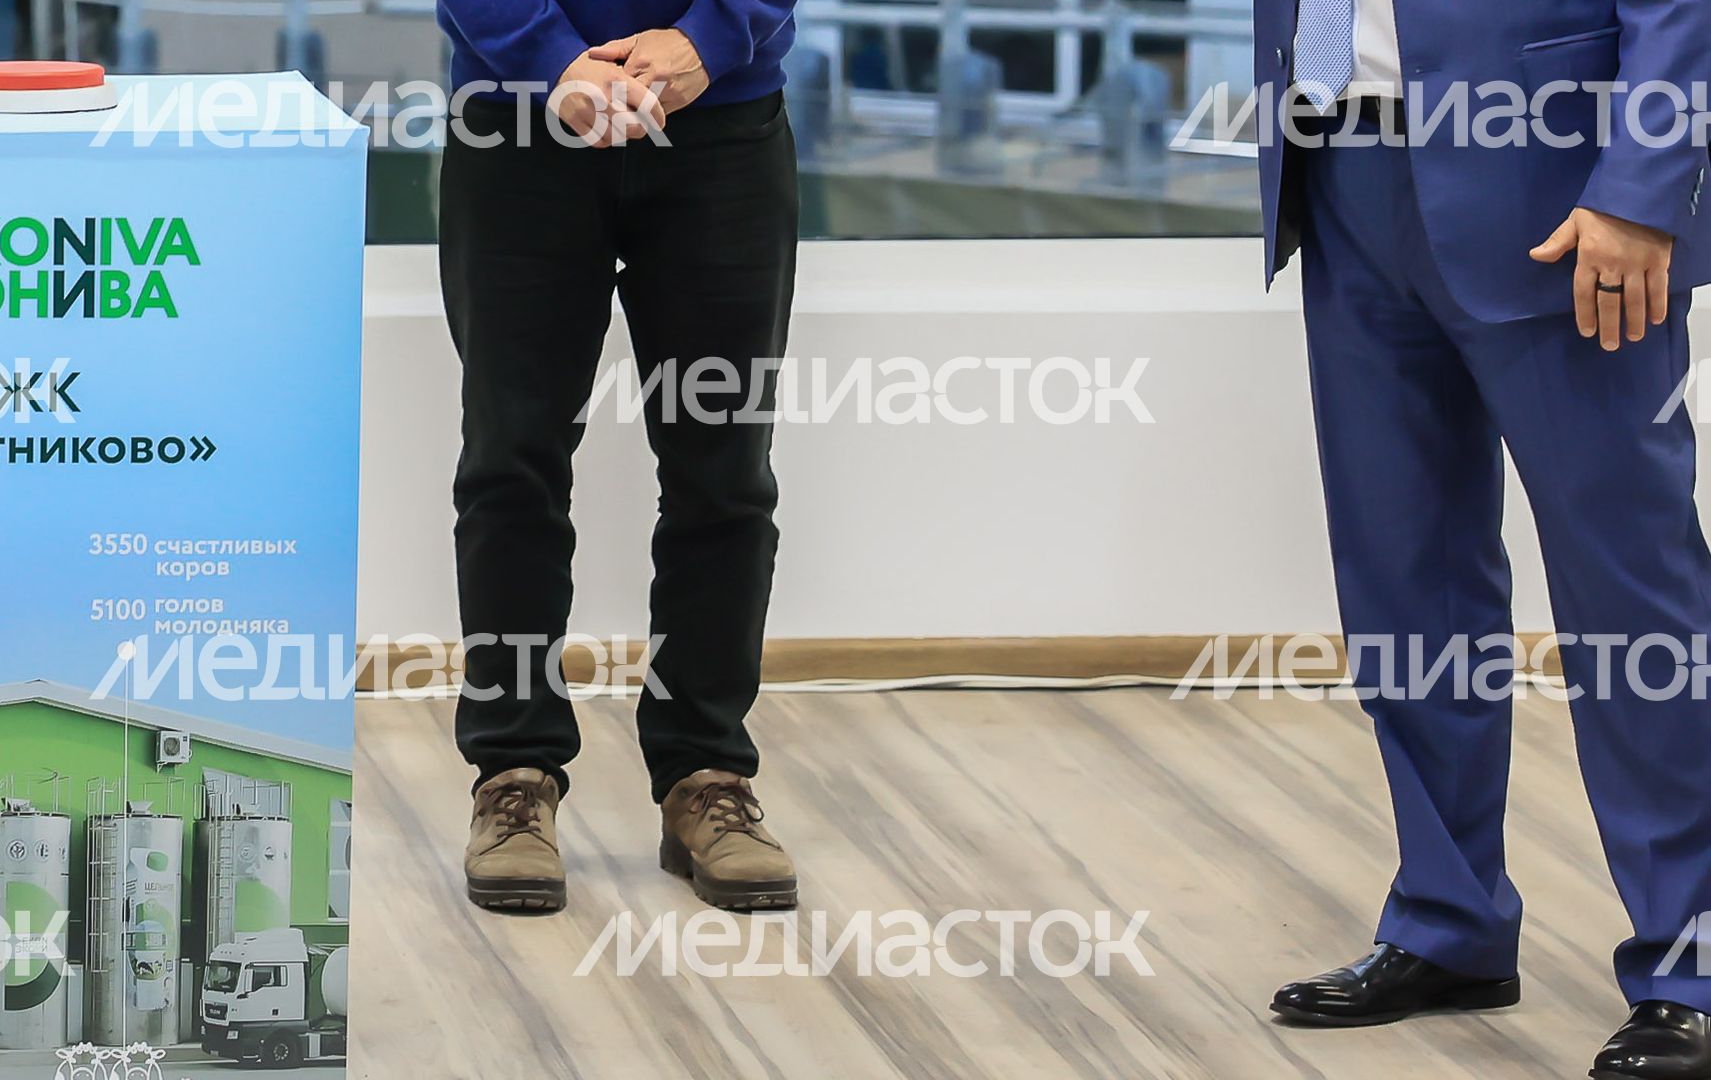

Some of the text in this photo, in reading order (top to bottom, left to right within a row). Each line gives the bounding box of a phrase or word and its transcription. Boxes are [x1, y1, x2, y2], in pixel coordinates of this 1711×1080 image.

[89, 533, 297, 556] 3550 счастливых
[156, 561, 230, 581] коров
[90, 598, 224, 620] 5100 голов
[154, 619, 289, 636] молодняка
